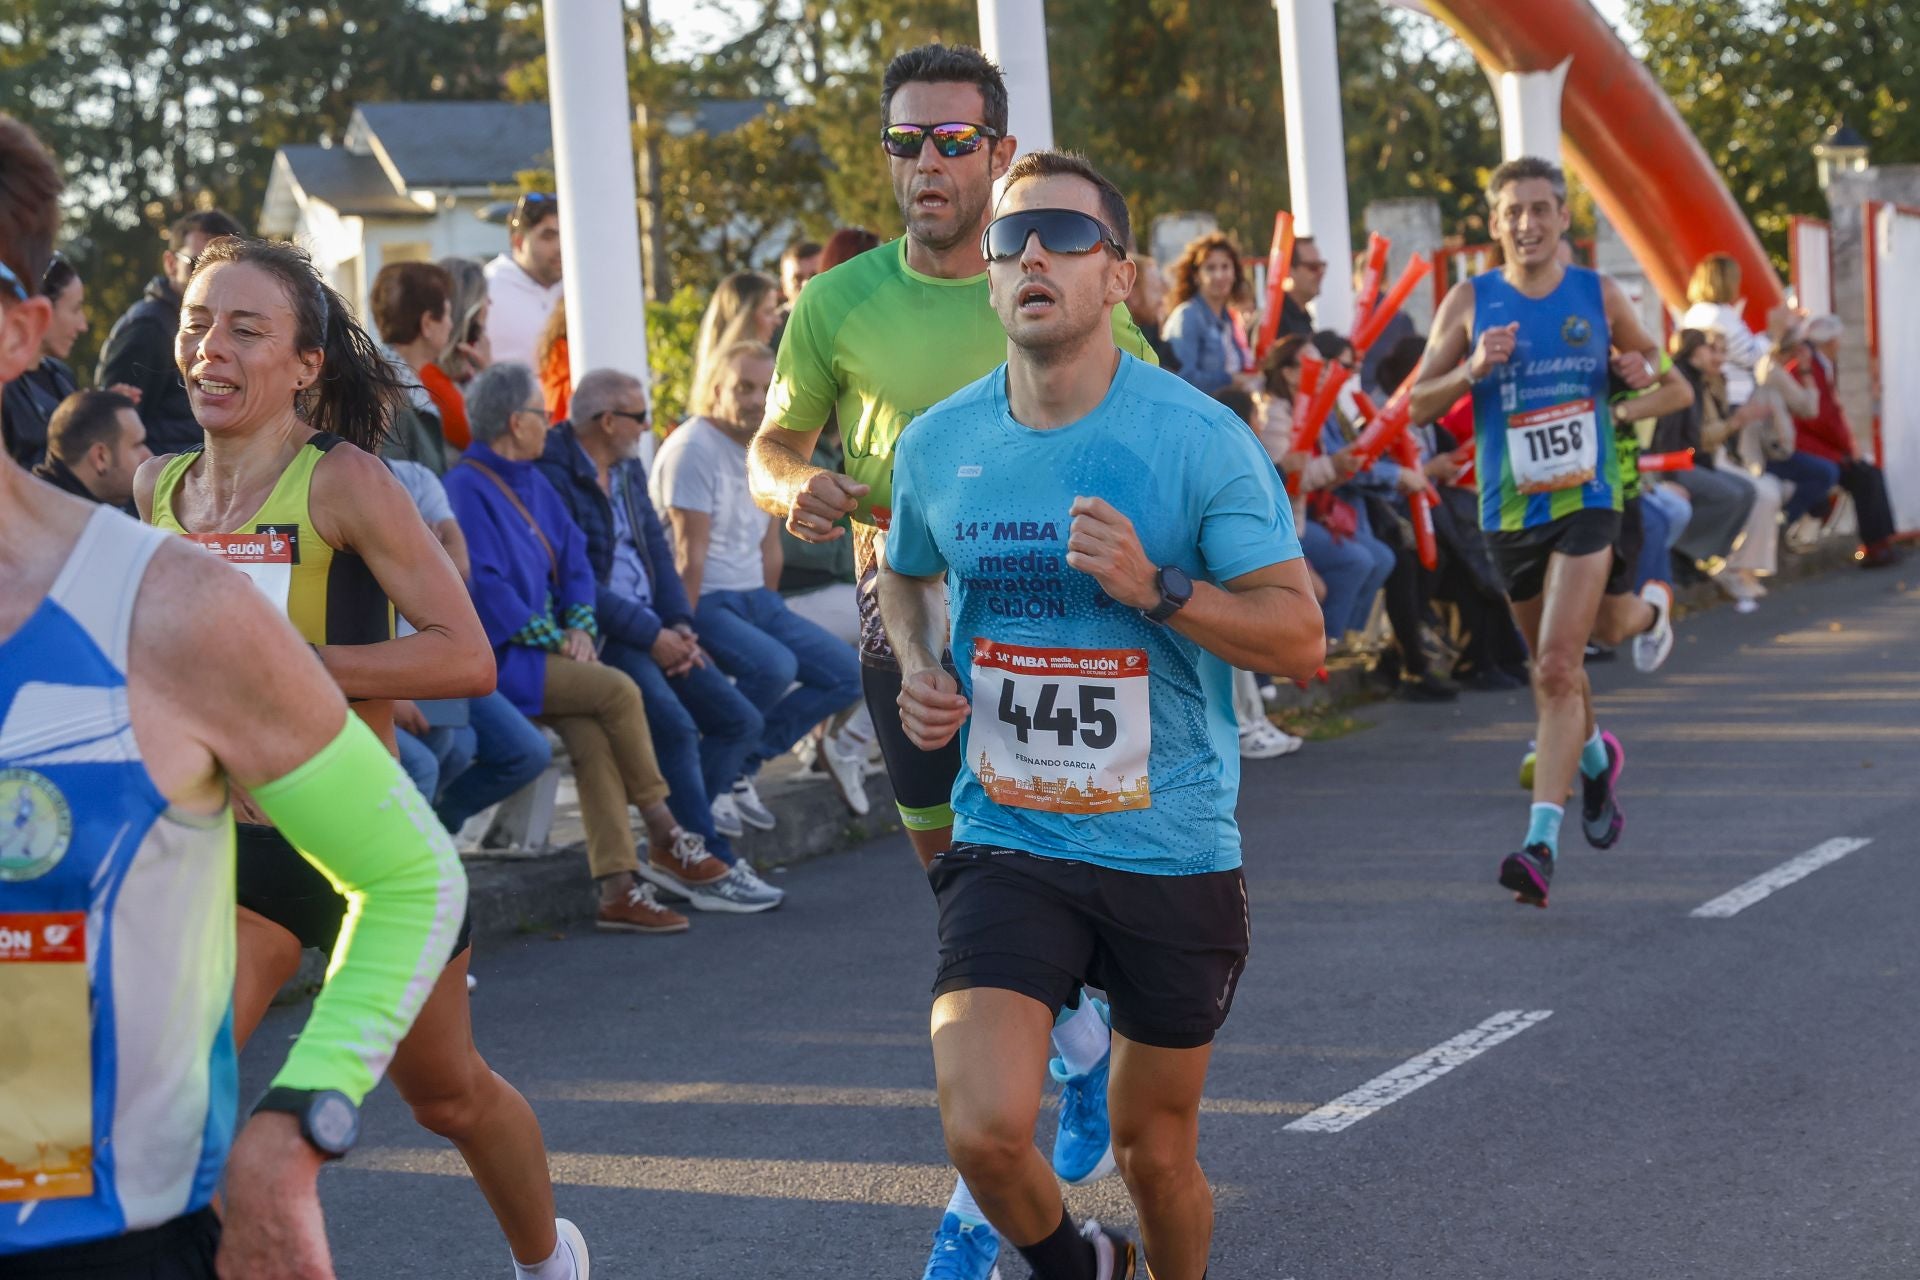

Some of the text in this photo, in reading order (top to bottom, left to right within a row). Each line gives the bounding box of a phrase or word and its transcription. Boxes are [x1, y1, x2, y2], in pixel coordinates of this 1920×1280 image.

[1525, 421, 1583, 461] 1158
[992, 522, 1058, 541] MBA
[227, 542, 265, 554] GIJÓN
[978, 551, 1060, 573] media
[1012, 655, 1048, 668] MBA
[1050, 661, 1080, 669] maratón
[1079, 657, 1119, 671] GIJÓN
[998, 678, 1117, 750] 445
[1015, 753, 1097, 770] FERNANDO GARCIA
